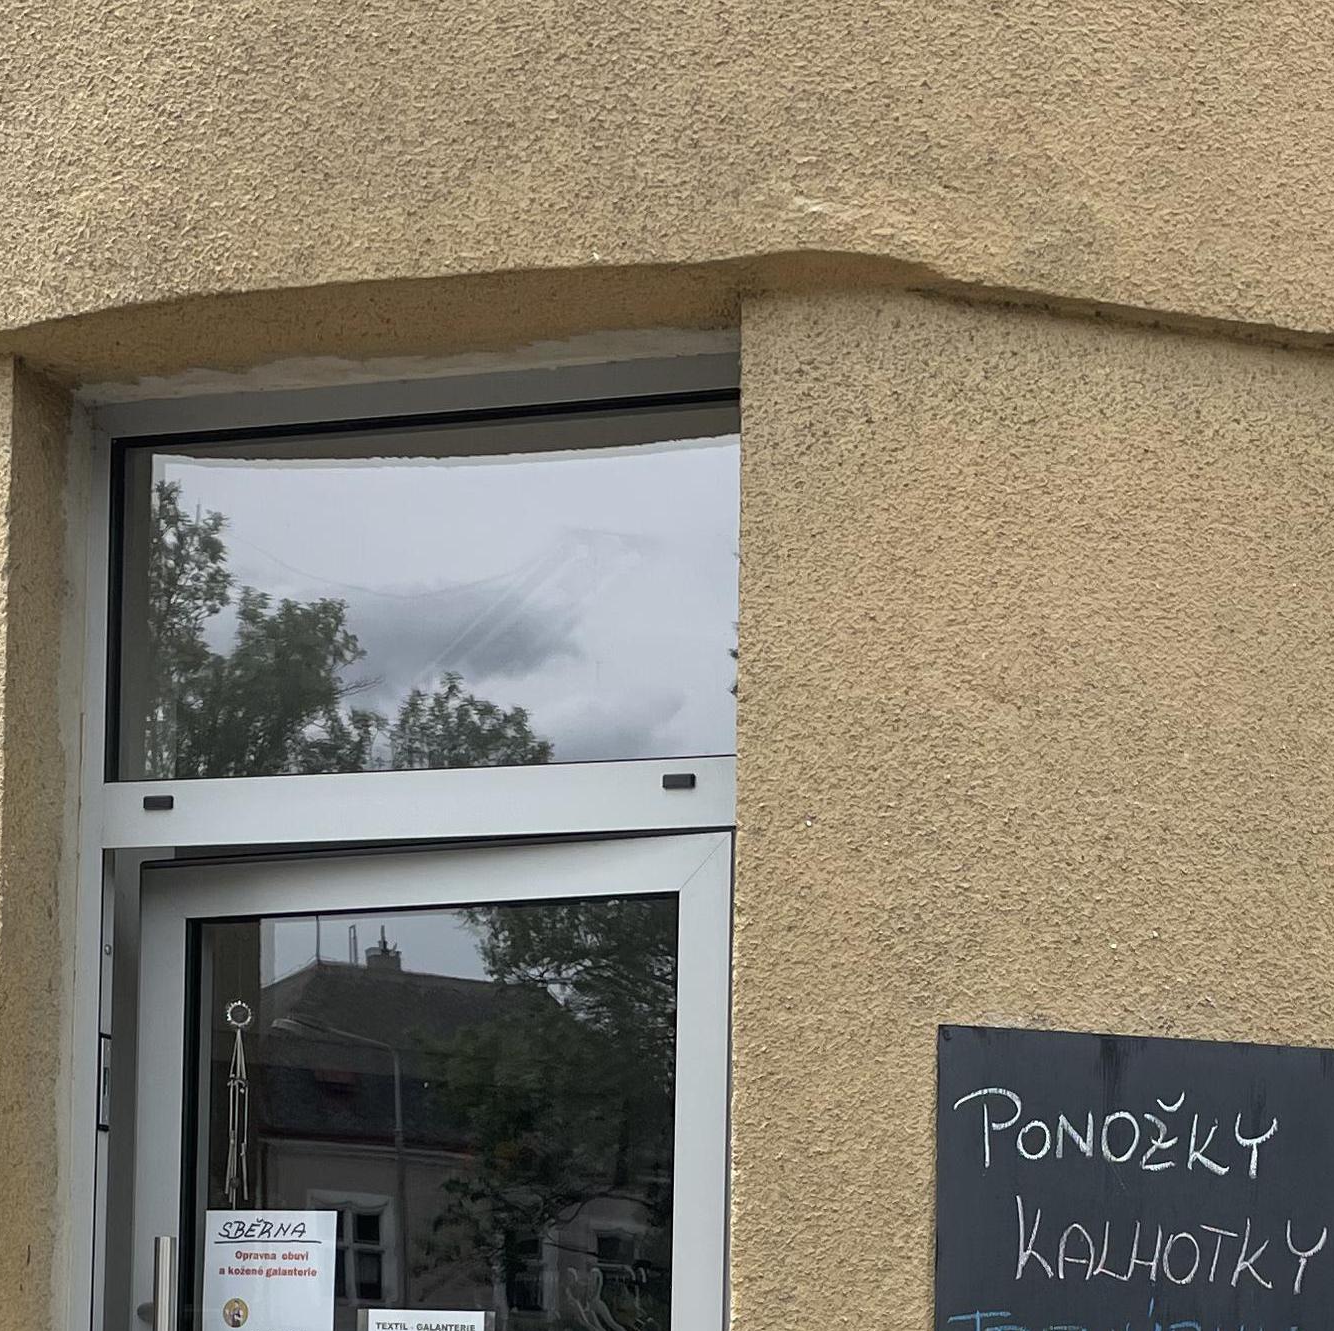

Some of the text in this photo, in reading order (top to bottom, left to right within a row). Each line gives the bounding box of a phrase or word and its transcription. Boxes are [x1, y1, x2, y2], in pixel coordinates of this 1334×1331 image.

[218, 1217, 307, 1239] SBĚRNA
[1014, 1194, 1327, 1294] KALHOTKY
[235, 1250, 277, 1262] Opravna
[266, 1266, 317, 1278] galanterie
[376, 1322, 408, 1331] TEXTIL
[416, 1323, 476, 1331] GALANTERIE
